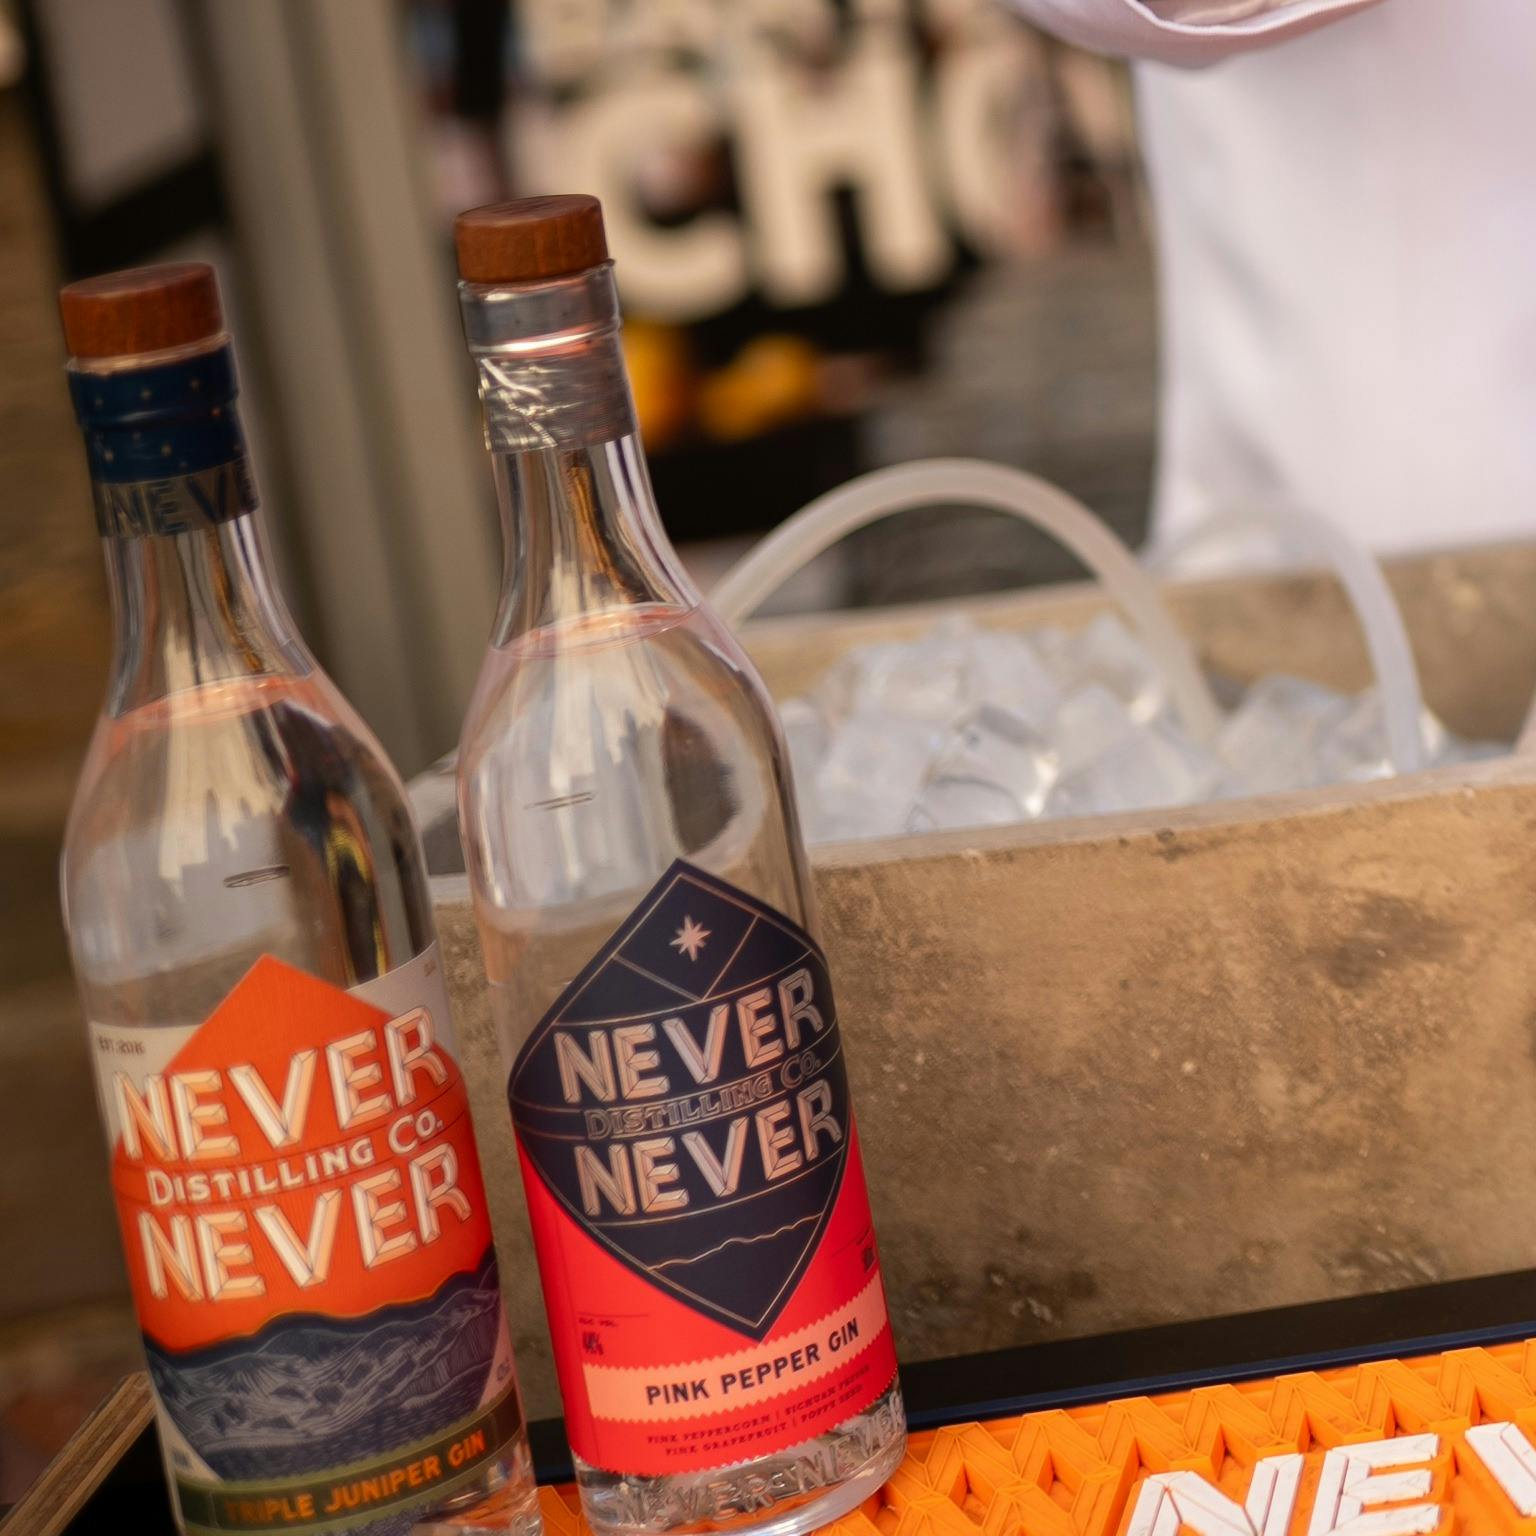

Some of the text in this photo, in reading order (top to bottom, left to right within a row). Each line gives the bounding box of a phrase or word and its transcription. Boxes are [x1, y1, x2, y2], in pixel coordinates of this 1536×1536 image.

[113, 1005, 448, 1162] NEVER
[553, 968, 824, 1105] NEVER
[573, 1078, 843, 1216] NEVER
[584, 1072, 774, 1141] DISTILLING
[146, 1138, 375, 1207] DISTILLING
[137, 1142, 471, 1302] NEVER
[645, 1317, 860, 1406] PINK PEPPER GIN
[647, 1434, 678, 1445] PINK
[682, 1413, 770, 1443] PEPPERCORN
[224, 1430, 487, 1524] TRIPLE JUNIPER GIN
